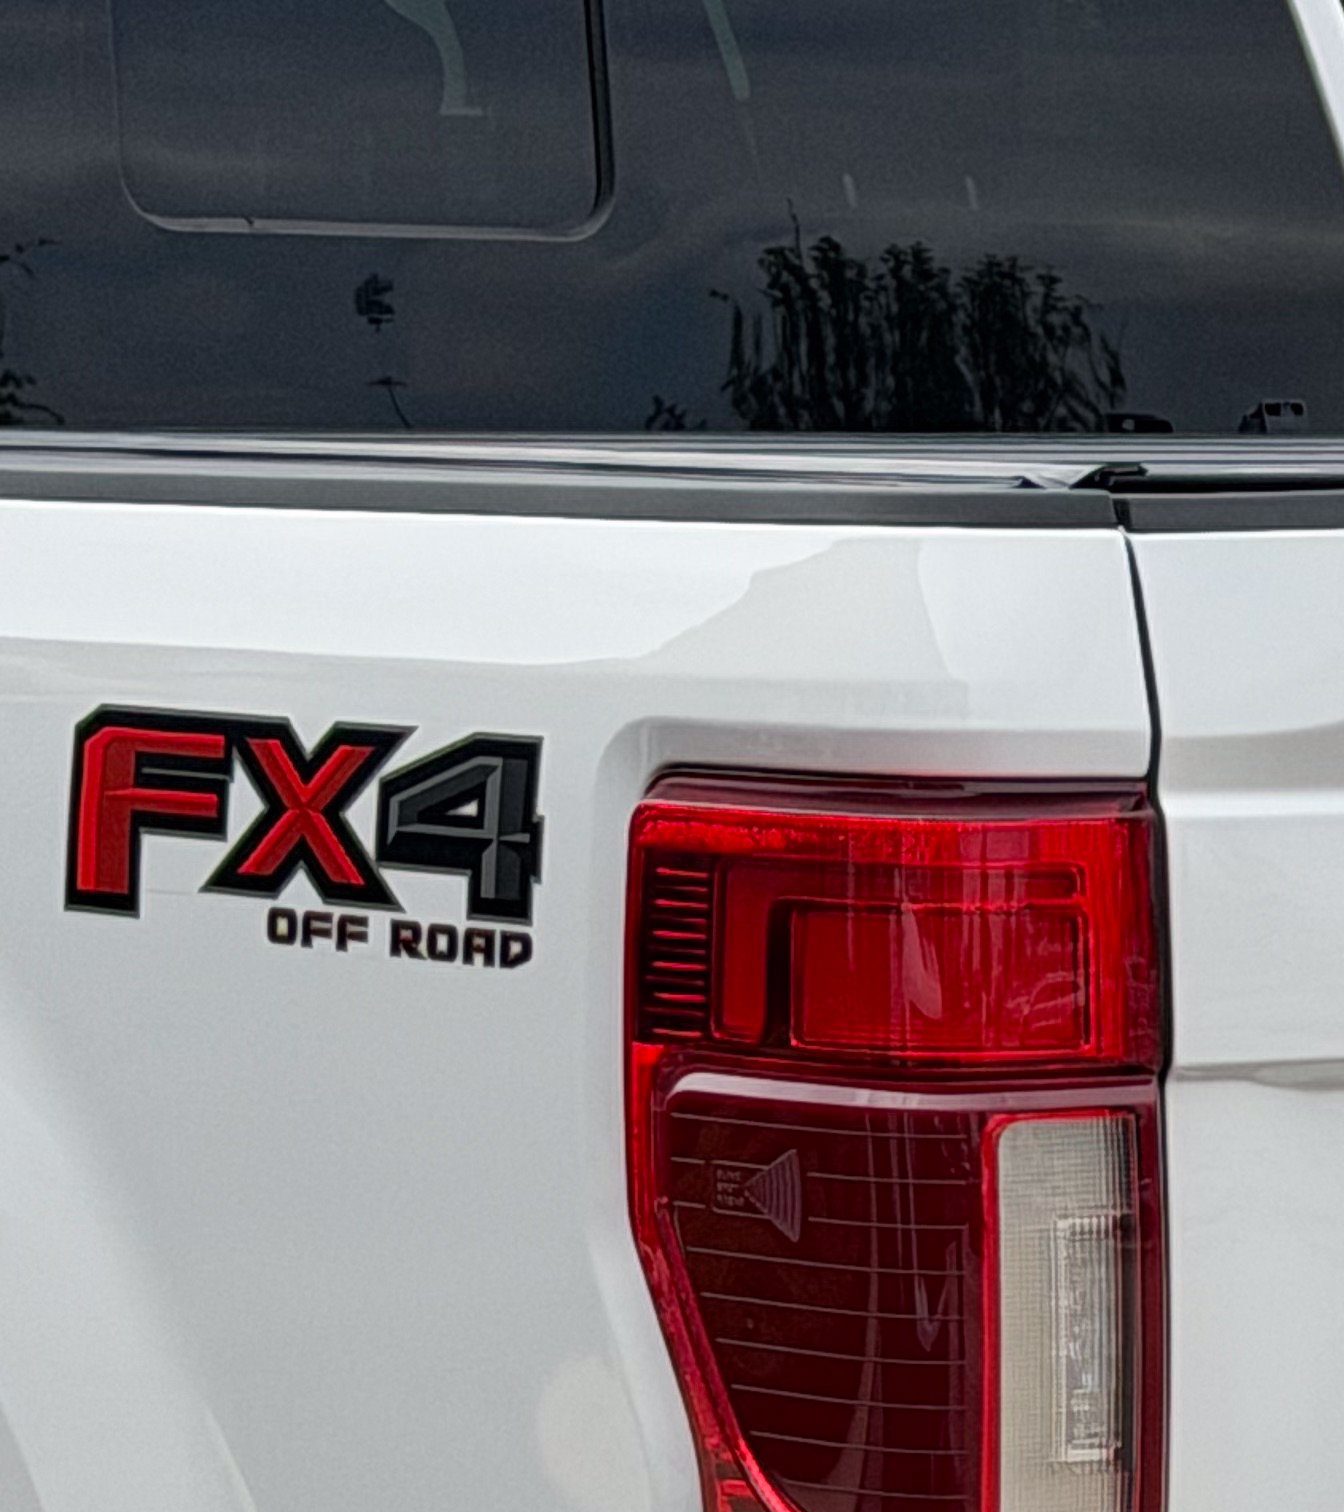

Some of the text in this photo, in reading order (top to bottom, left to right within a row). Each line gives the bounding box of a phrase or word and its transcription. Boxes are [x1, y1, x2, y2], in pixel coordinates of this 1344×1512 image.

[64, 703, 544, 926] FX4
[267, 906, 533, 969] OFF ROAD
